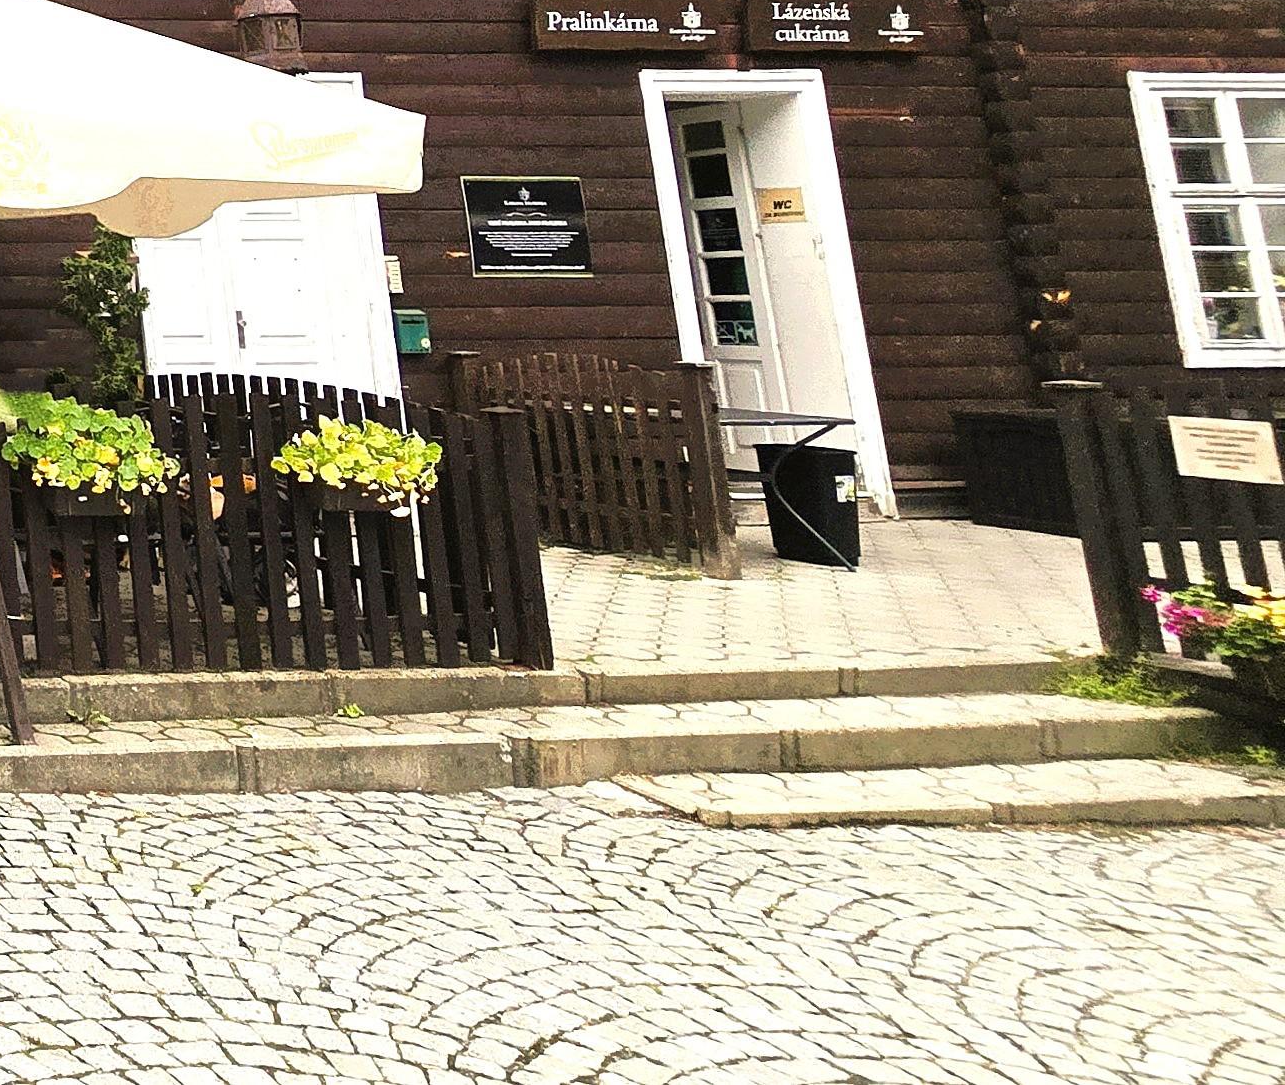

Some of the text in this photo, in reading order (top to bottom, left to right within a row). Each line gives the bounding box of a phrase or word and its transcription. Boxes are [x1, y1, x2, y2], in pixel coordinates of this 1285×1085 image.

[546, 10, 660, 32] Pralinkárna
[771, 1, 851, 21] Lázeňská
[775, 22, 851, 42] cukrárna
[773, 200, 792, 210] WC
